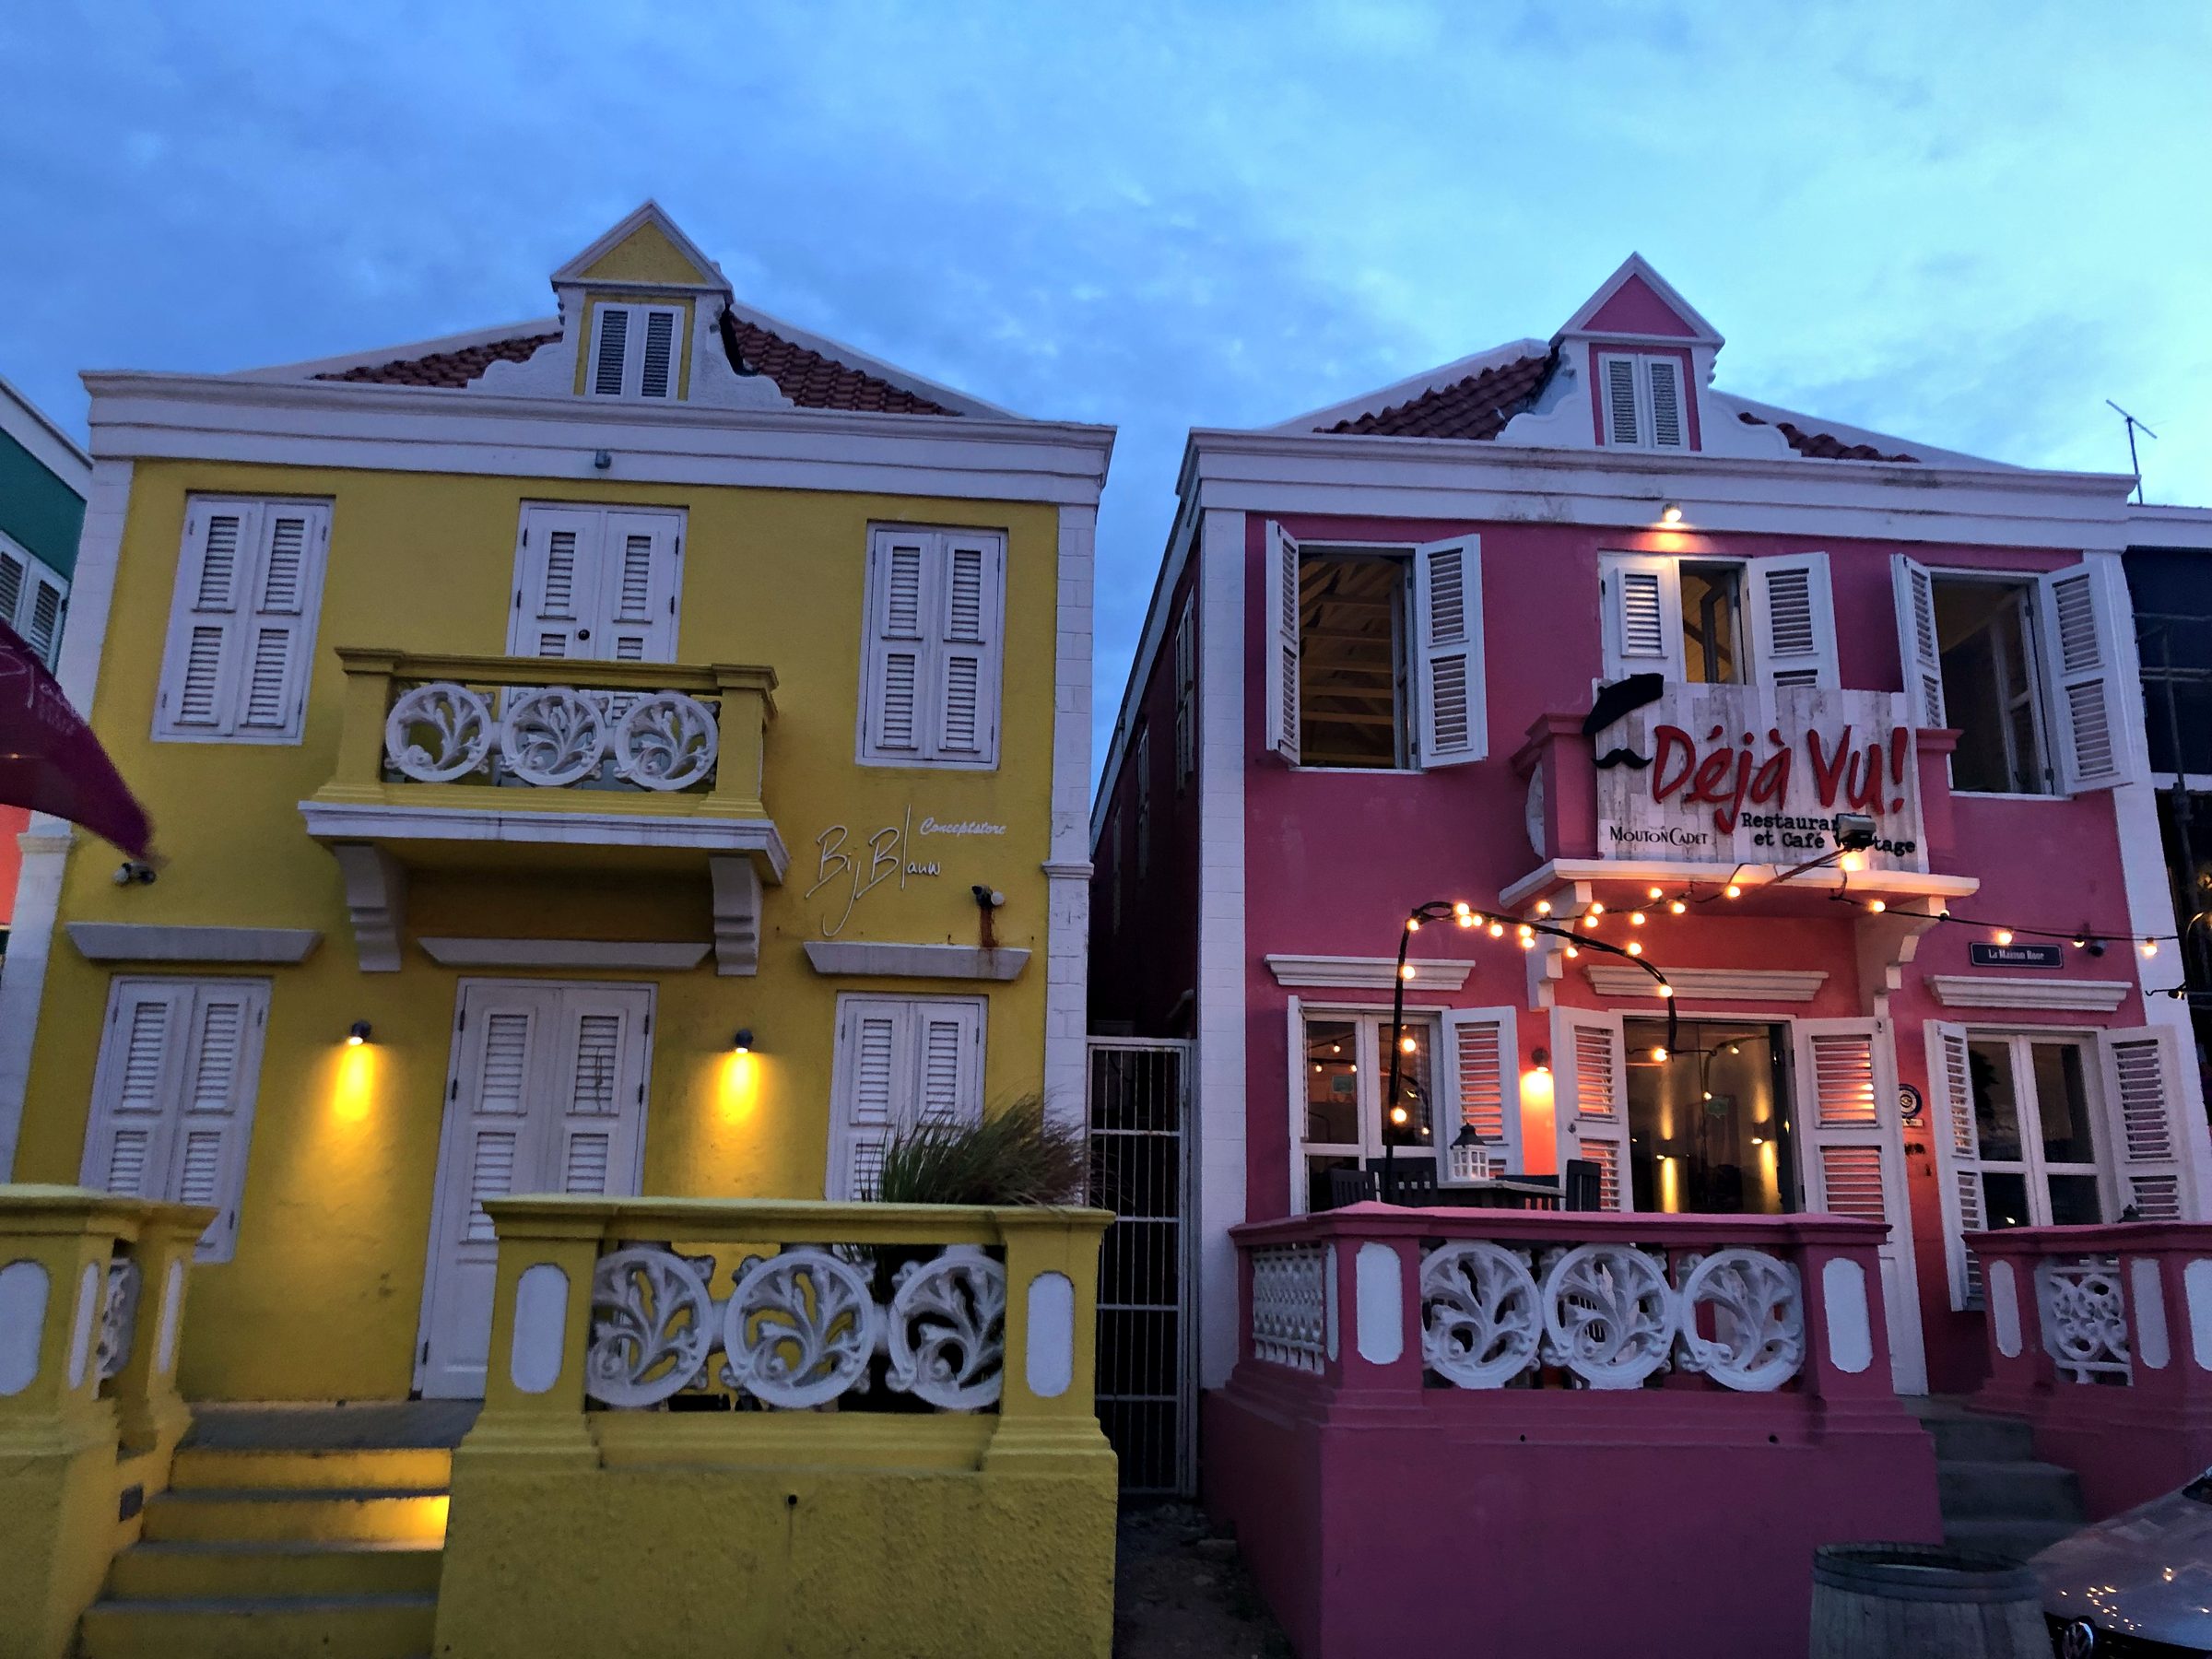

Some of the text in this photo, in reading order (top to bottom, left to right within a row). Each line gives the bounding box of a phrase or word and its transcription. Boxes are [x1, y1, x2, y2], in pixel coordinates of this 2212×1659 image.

[1653, 725, 1909, 834] Déjà Vu!
[1754, 830, 1916, 856] et Café Vtage
